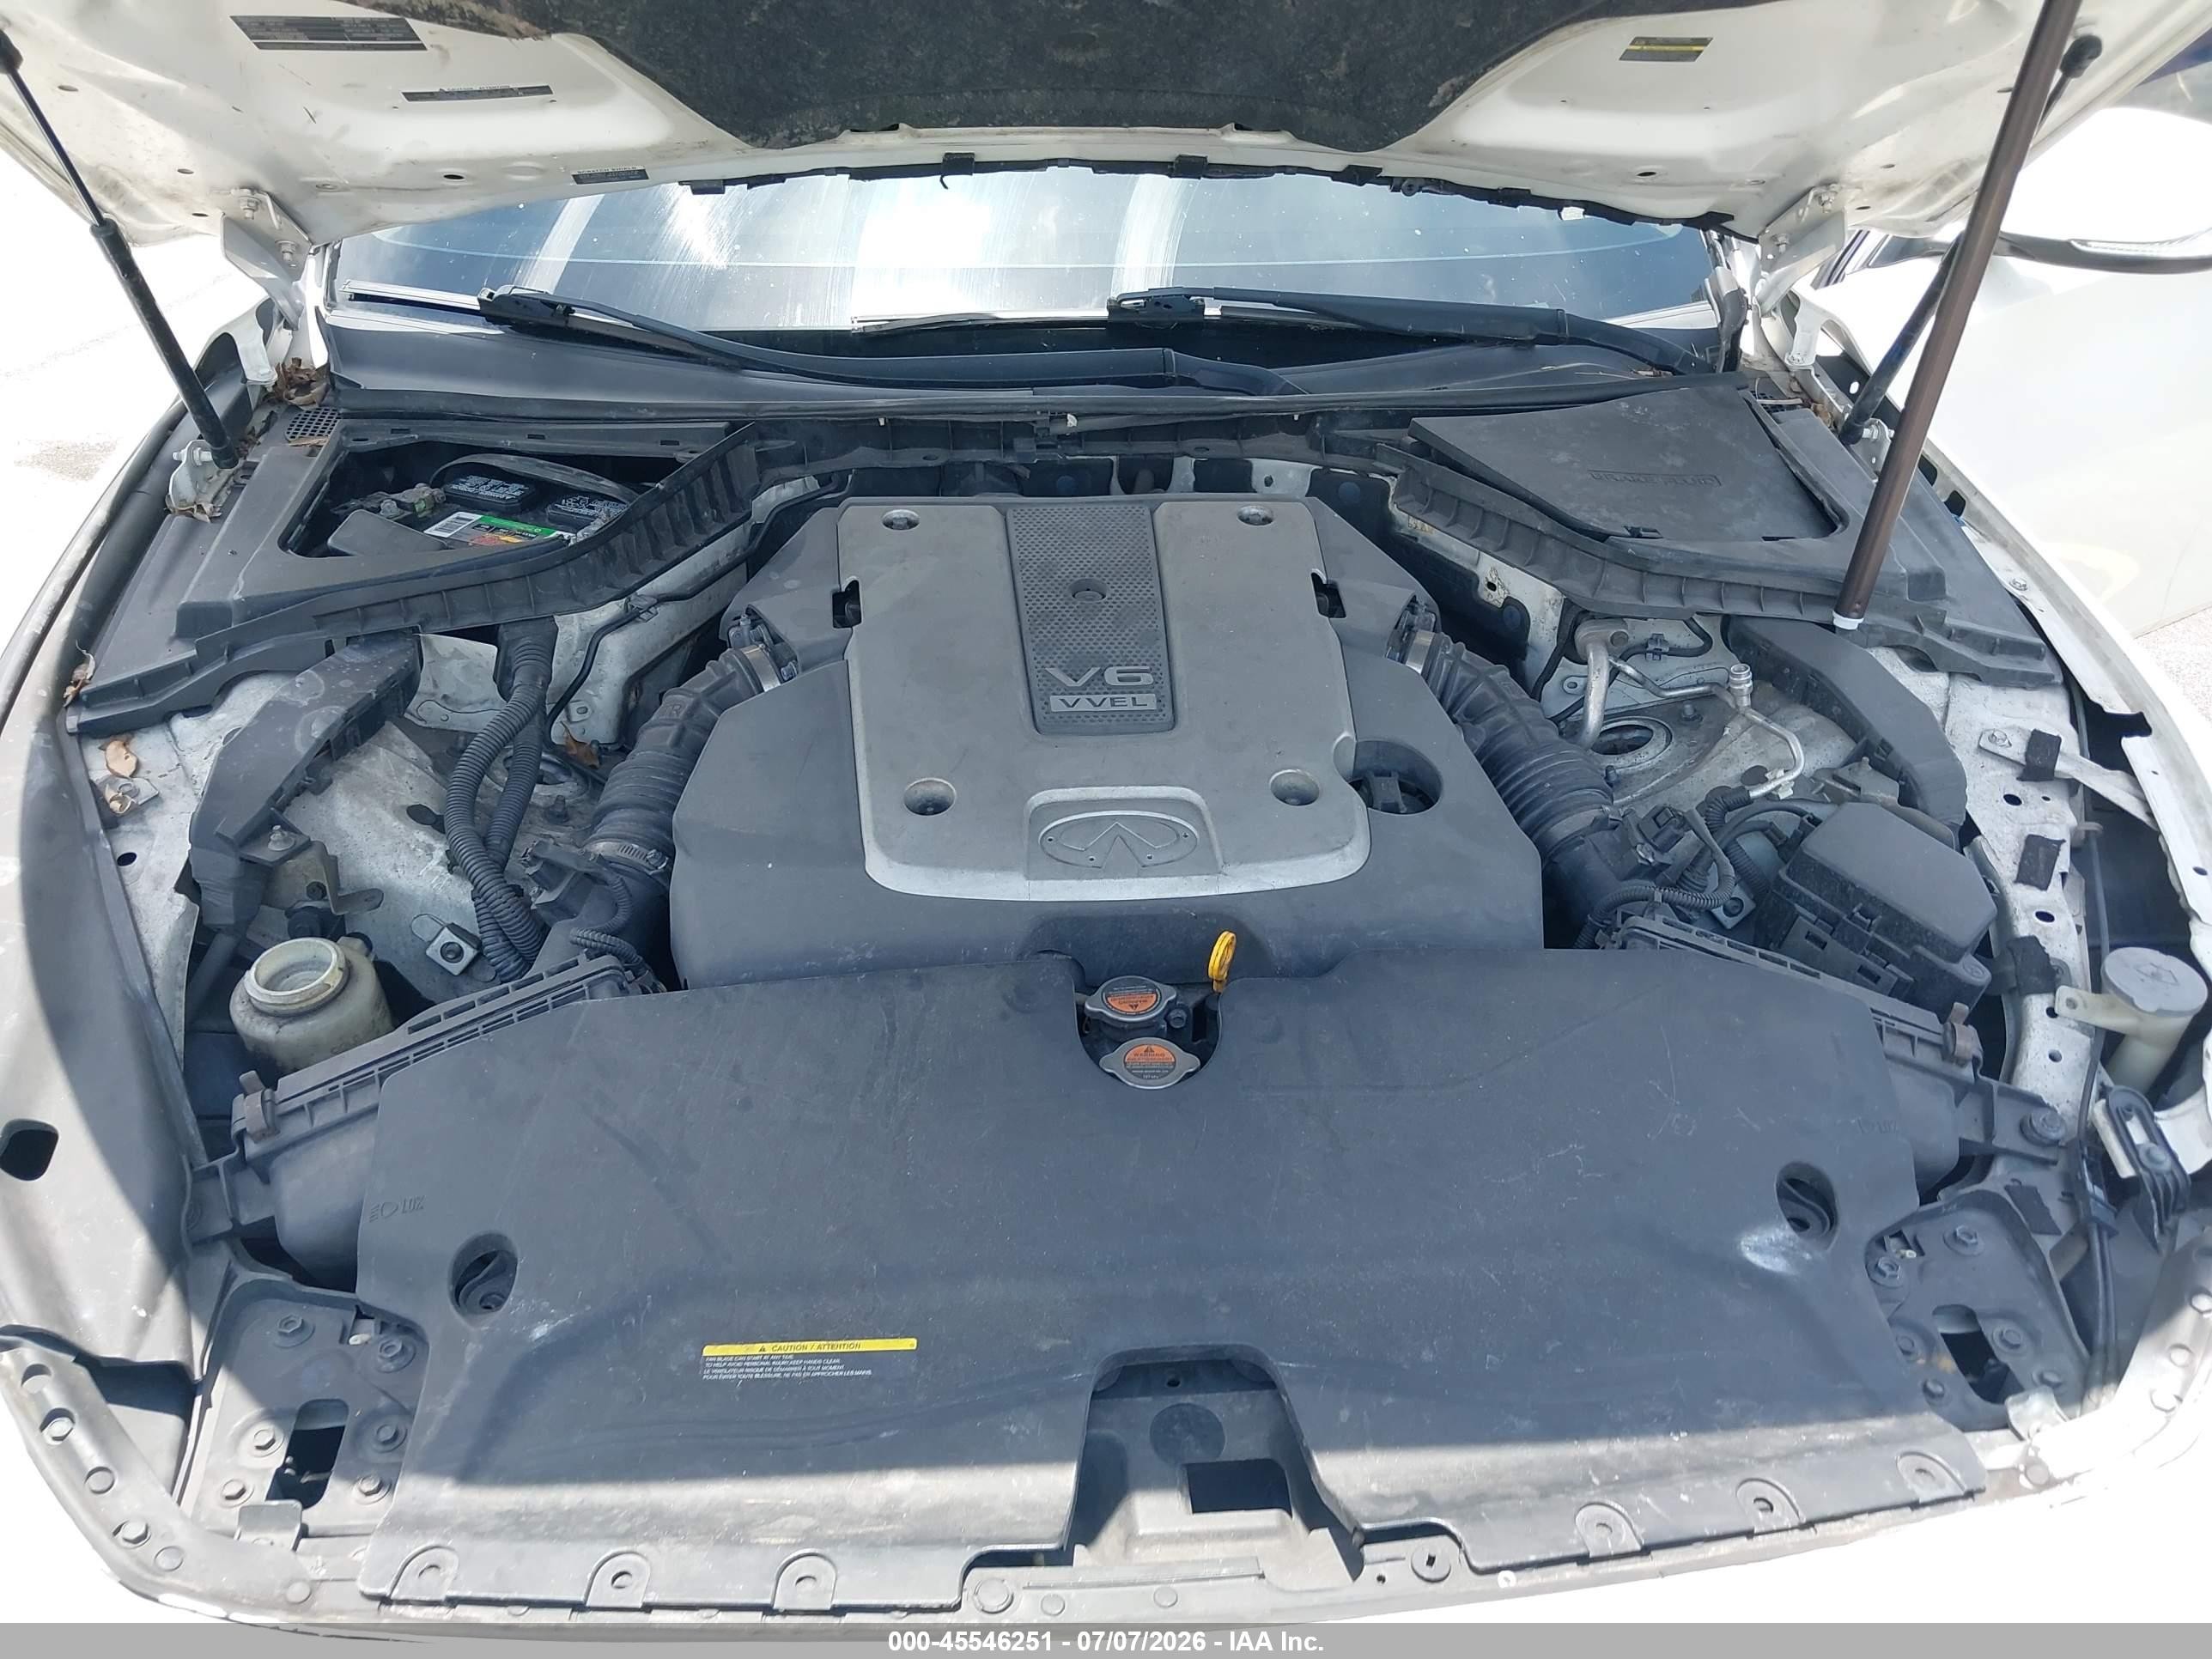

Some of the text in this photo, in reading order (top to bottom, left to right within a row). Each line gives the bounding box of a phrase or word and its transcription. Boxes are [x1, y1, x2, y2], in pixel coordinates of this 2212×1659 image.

[1591, 472, 1658, 484] BRAKE
[1044, 665, 1154, 687] V6
[1058, 696, 1148, 708] VVEL
[771, 1343, 808, 1352] CAUTION
[817, 1341, 861, 1351] ATTENTION
